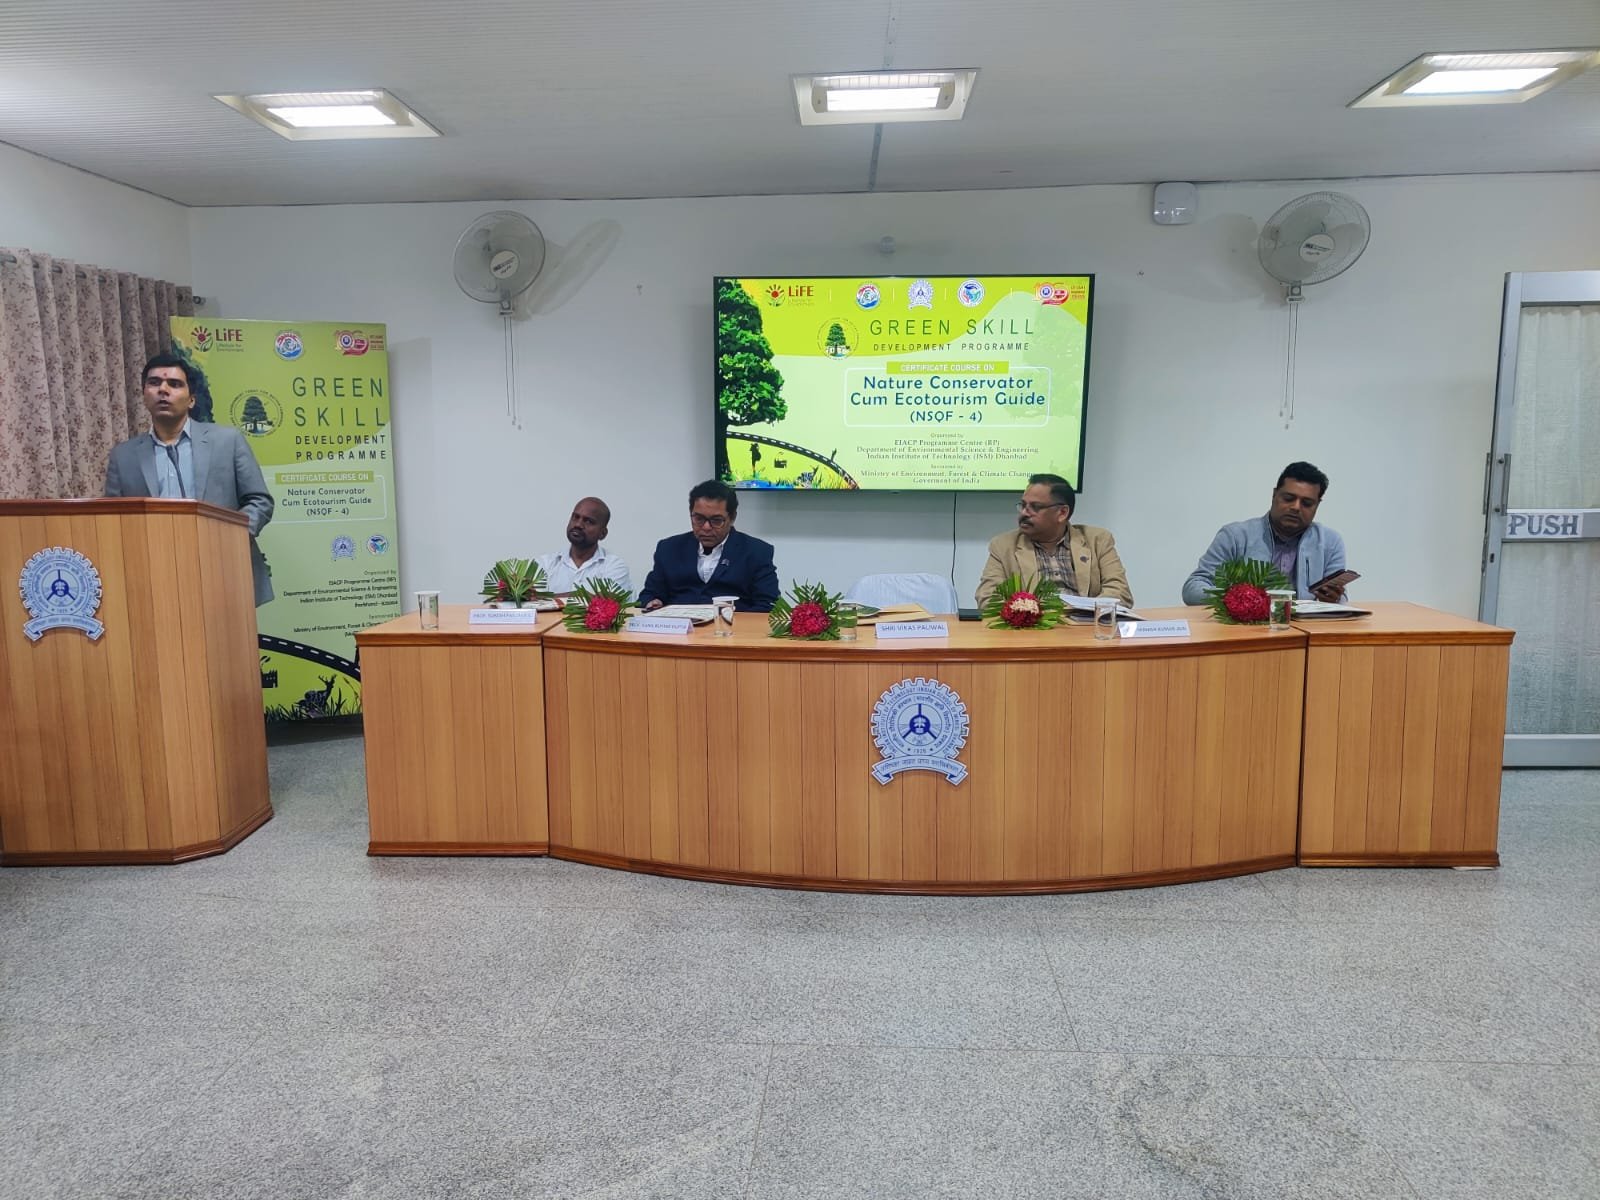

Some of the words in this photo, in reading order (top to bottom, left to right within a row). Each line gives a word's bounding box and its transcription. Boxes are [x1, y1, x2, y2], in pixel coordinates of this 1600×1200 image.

[788, 286, 814, 297] LiFE
[870, 320, 950, 336] GREEN
[966, 318, 1034, 335] SKILL
[215, 328, 243, 341] LiFE
[962, 342, 1029, 351] PROGRAMME
[292, 376, 383, 397] GREEN
[864, 376, 923, 389] Nature
[930, 376, 1033, 389] Conservator
[851, 392, 887, 405] Cum
[895, 392, 987, 405] Ecotourism
[995, 392, 1045, 405] Guide
[294, 406, 386, 427] SKILL
[910, 410, 953, 423] (NSQF
[970, 410, 982, 423] 4)
[295, 434, 386, 445] DEVELOPMENT
[296, 450, 386, 460] PROGRAMME
[857, 446, 897, 454] Department
[281, 474, 326, 482] CERTIFICATE
[329, 473, 356, 481] COURSE
[288, 488, 315, 496] Nature
[303, 498, 347, 506] Ecotourism
[306, 508, 332, 516] (NSQF
[341, 507, 350, 515] 4)
[1508, 514, 1579, 536] PUSH
